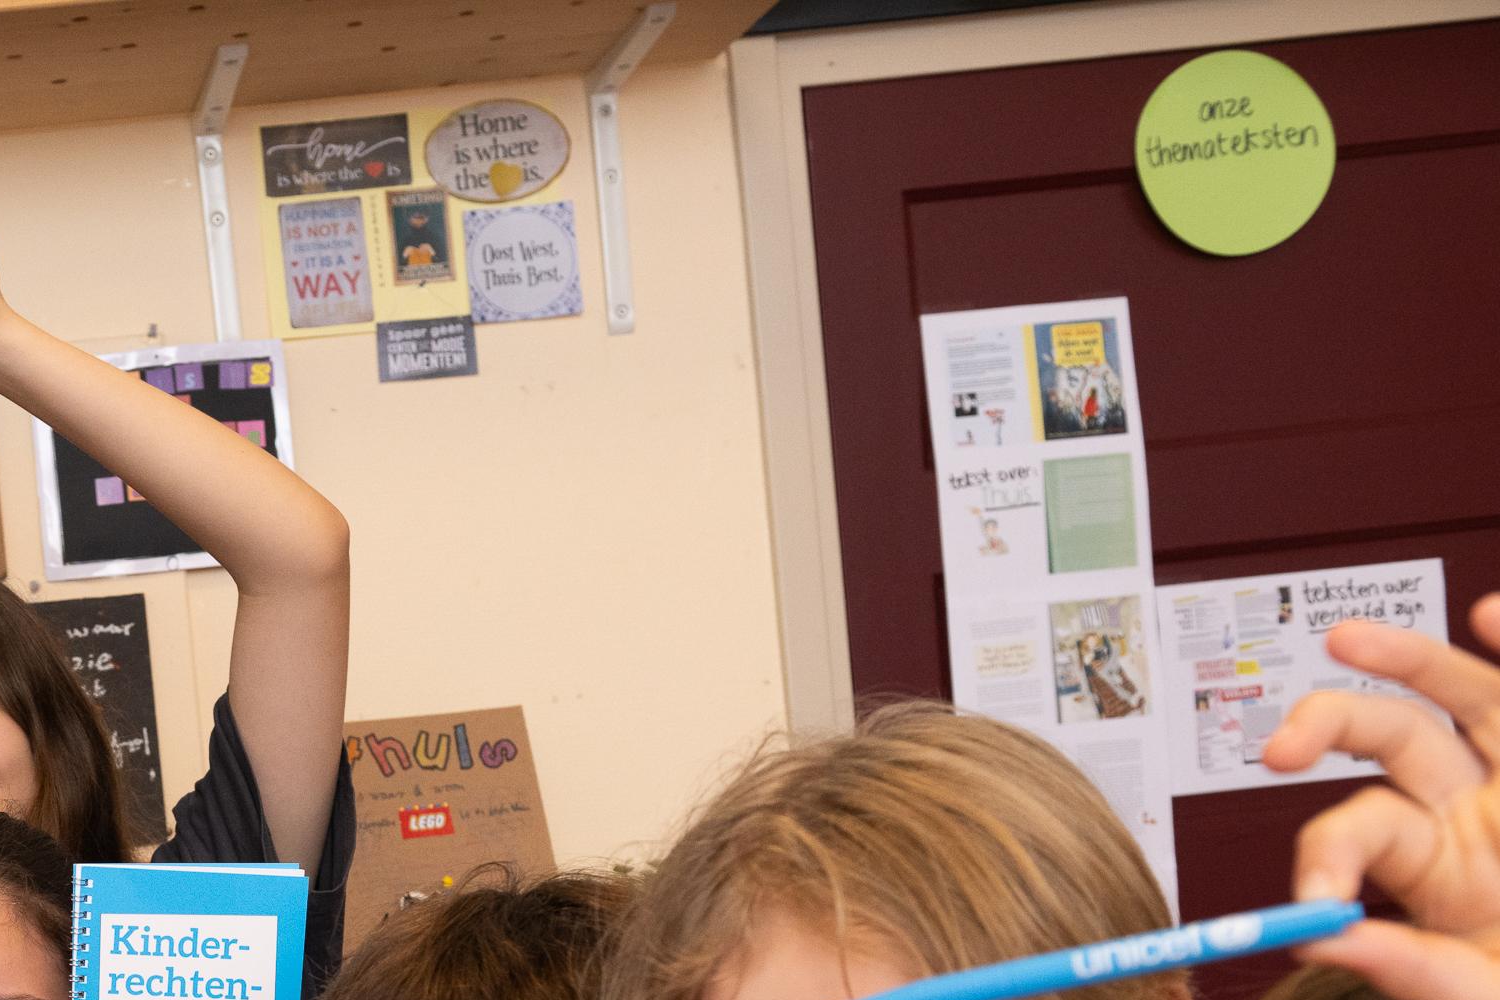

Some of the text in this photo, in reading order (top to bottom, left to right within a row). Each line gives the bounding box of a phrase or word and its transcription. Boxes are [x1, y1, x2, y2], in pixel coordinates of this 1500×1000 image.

[1198, 96, 1252, 123] onze
[459, 113, 528, 137] Home
[454, 137, 539, 165] is where
[1145, 124, 1320, 169] themateksten
[455, 167, 490, 190] the
[287, 225, 301, 239] IS
[307, 222, 340, 237] NOT
[336, 255, 346, 265] A
[482, 243, 515, 265] Oost
[292, 269, 360, 300] WAY
[483, 267, 522, 290] Thuis
[1302, 577, 1380, 605] teksten
[1305, 600, 1387, 628] verliefd
[409, 814, 445, 831] LEGO
[109, 924, 250, 960] Kinder-
[1070, 924, 1204, 979] unicef
[107, 966, 263, 1000] rechten-
